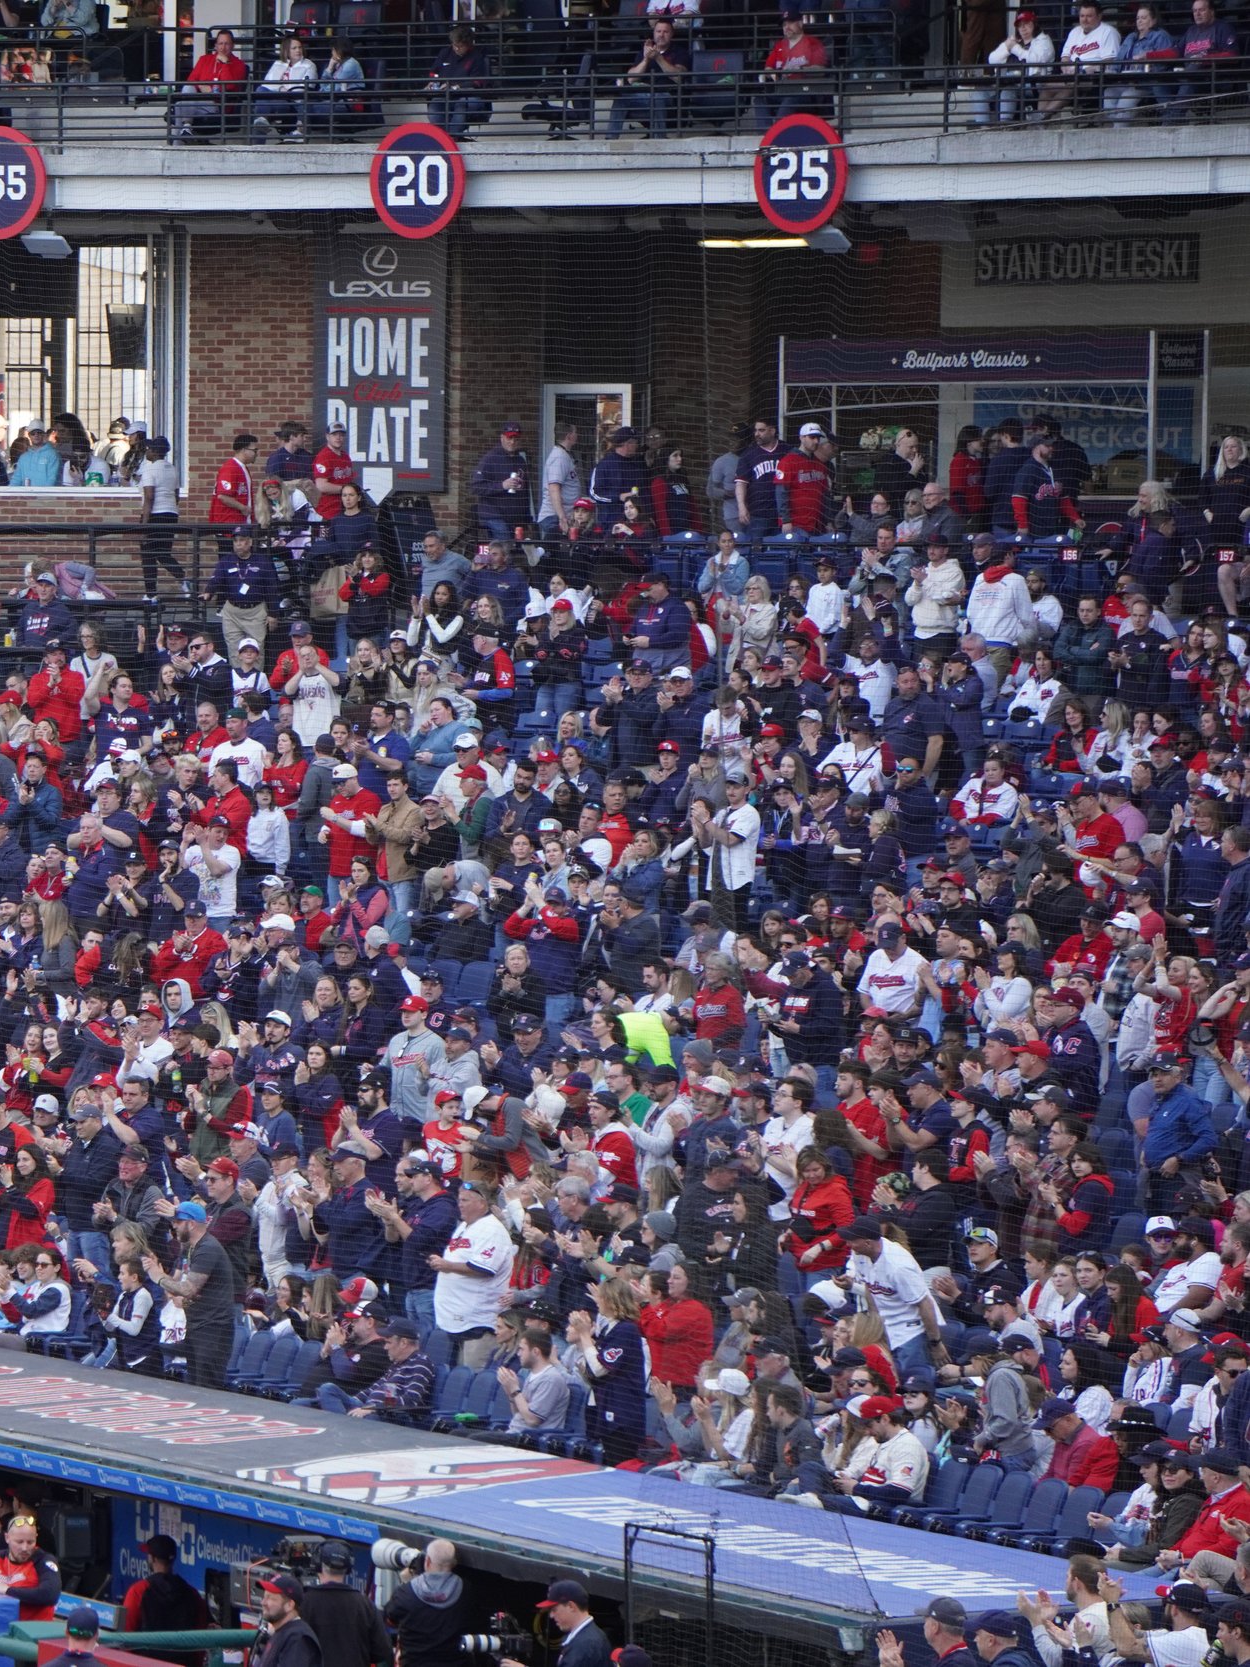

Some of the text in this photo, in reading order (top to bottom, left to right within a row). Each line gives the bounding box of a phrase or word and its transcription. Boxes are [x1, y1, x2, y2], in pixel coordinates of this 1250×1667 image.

[386, 155, 448, 206] 20
[768, 149, 829, 200] 25
[977, 240, 1189, 281] STAN COVELESKI
[328, 280, 431, 298] LEXUS
[327, 317, 430, 388] HOME
[902, 349, 1030, 371] Ballpark Classics
[353, 379, 404, 402] Club
[1219, 550, 1234, 561] 157
[431, 1012, 444, 1028] C
[1065, 1038, 1081, 1054] C
[197, 1531, 237, 1562] Cleveland
